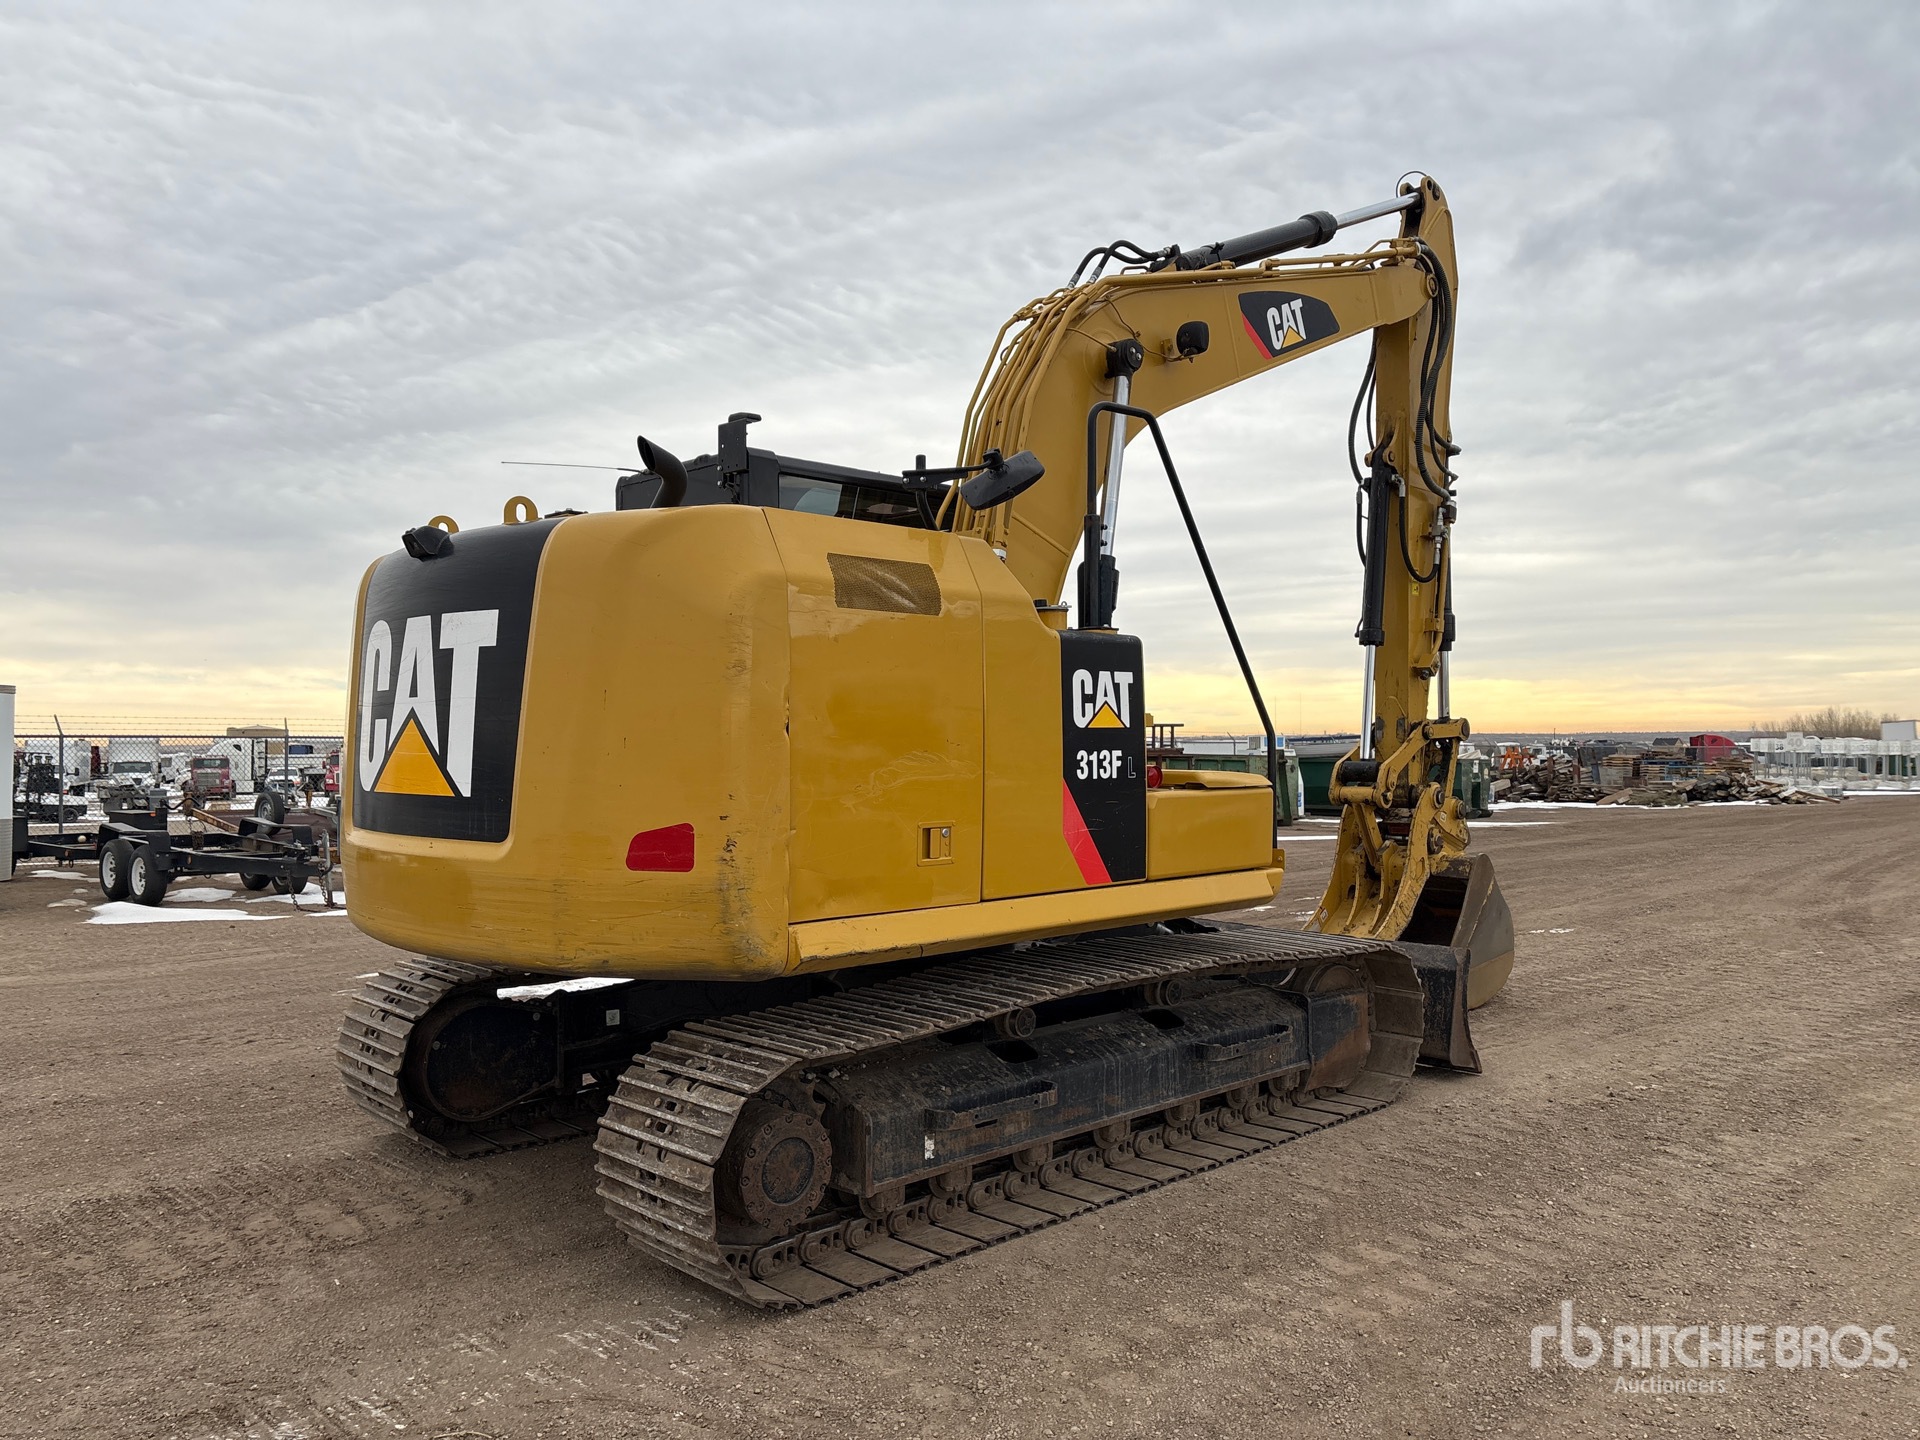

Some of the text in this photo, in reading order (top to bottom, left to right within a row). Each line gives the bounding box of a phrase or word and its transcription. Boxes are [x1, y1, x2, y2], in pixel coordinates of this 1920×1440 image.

[1266, 298, 1307, 351] CAT
[359, 609, 499, 797] CAT
[1072, 669, 1134, 729] CAT
[1076, 749, 1137, 780] 313F L
[1787, 738, 1803, 748] 40
